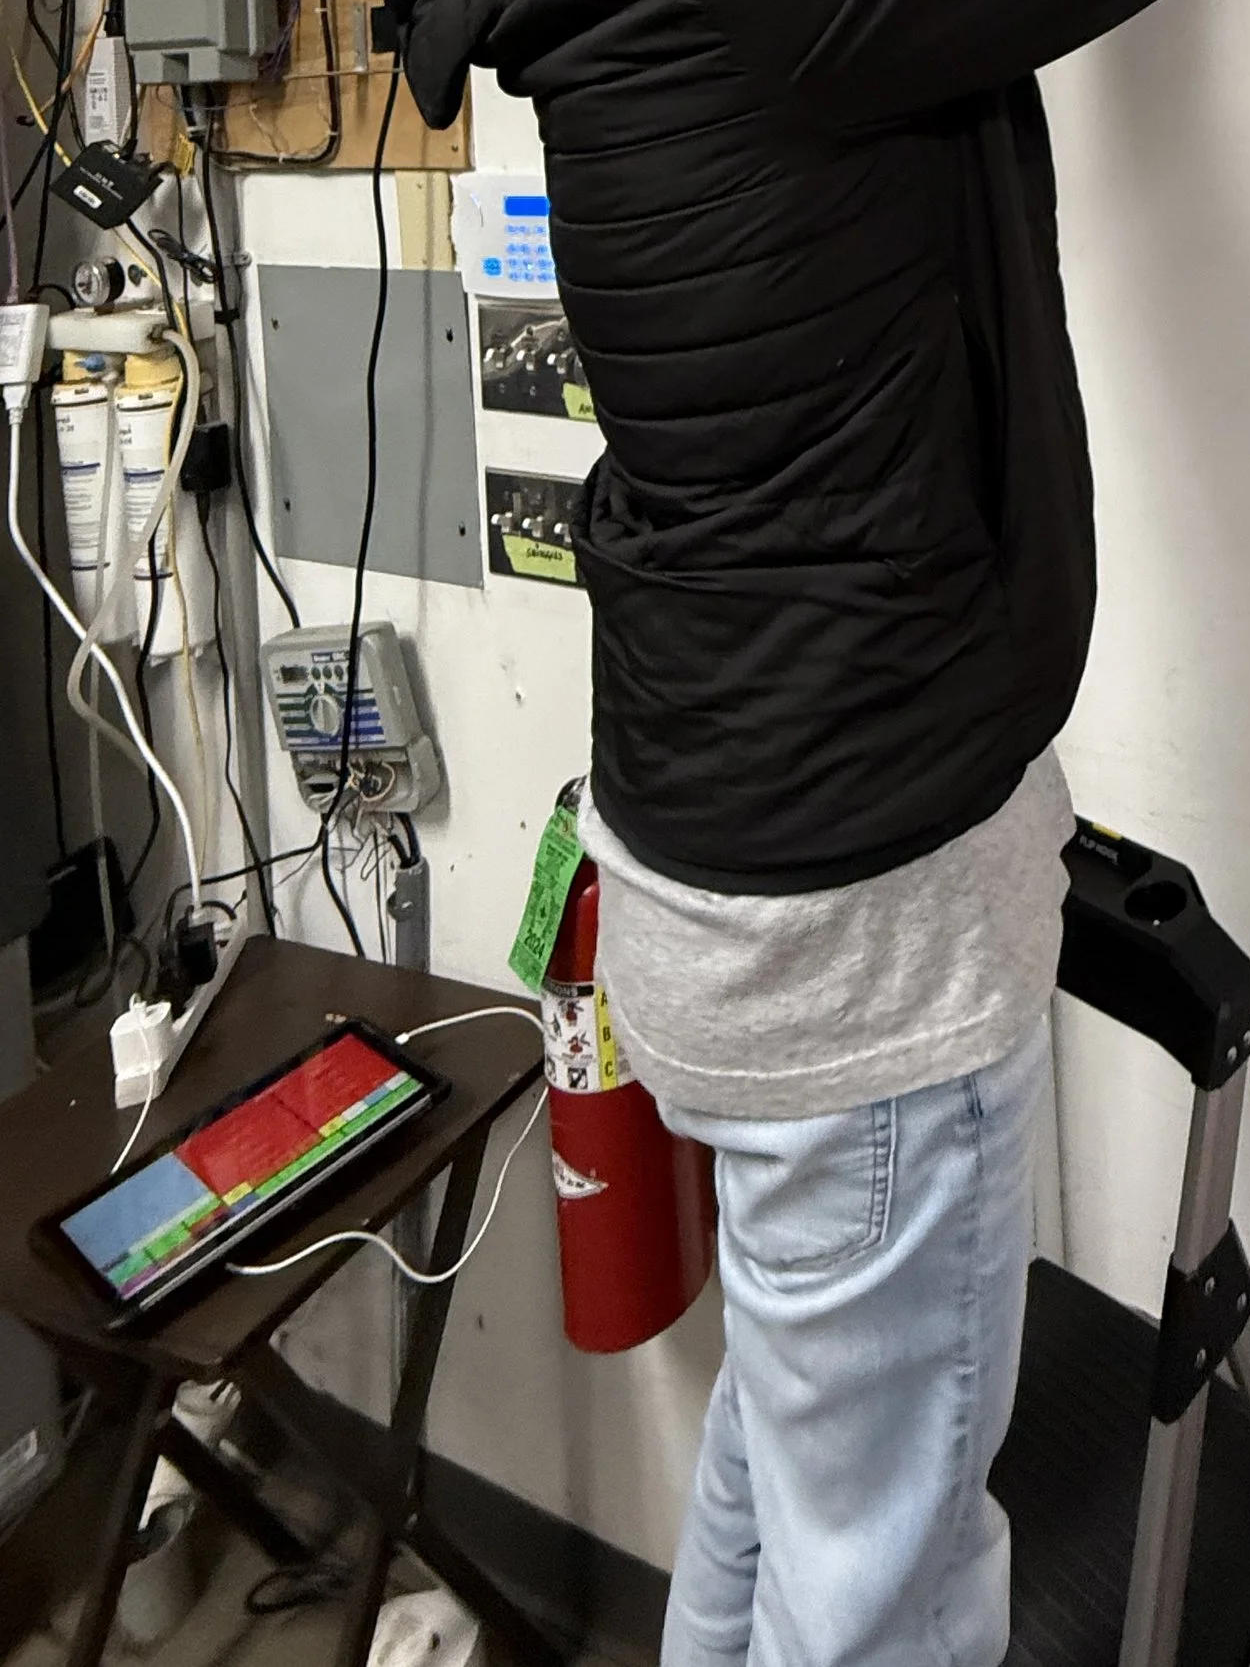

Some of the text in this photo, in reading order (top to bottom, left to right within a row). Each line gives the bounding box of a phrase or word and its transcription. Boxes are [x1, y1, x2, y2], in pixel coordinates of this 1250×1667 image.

[524, 929, 545, 960] 2024
[602, 1026, 611, 1043] B
[604, 1061, 614, 1077] C
